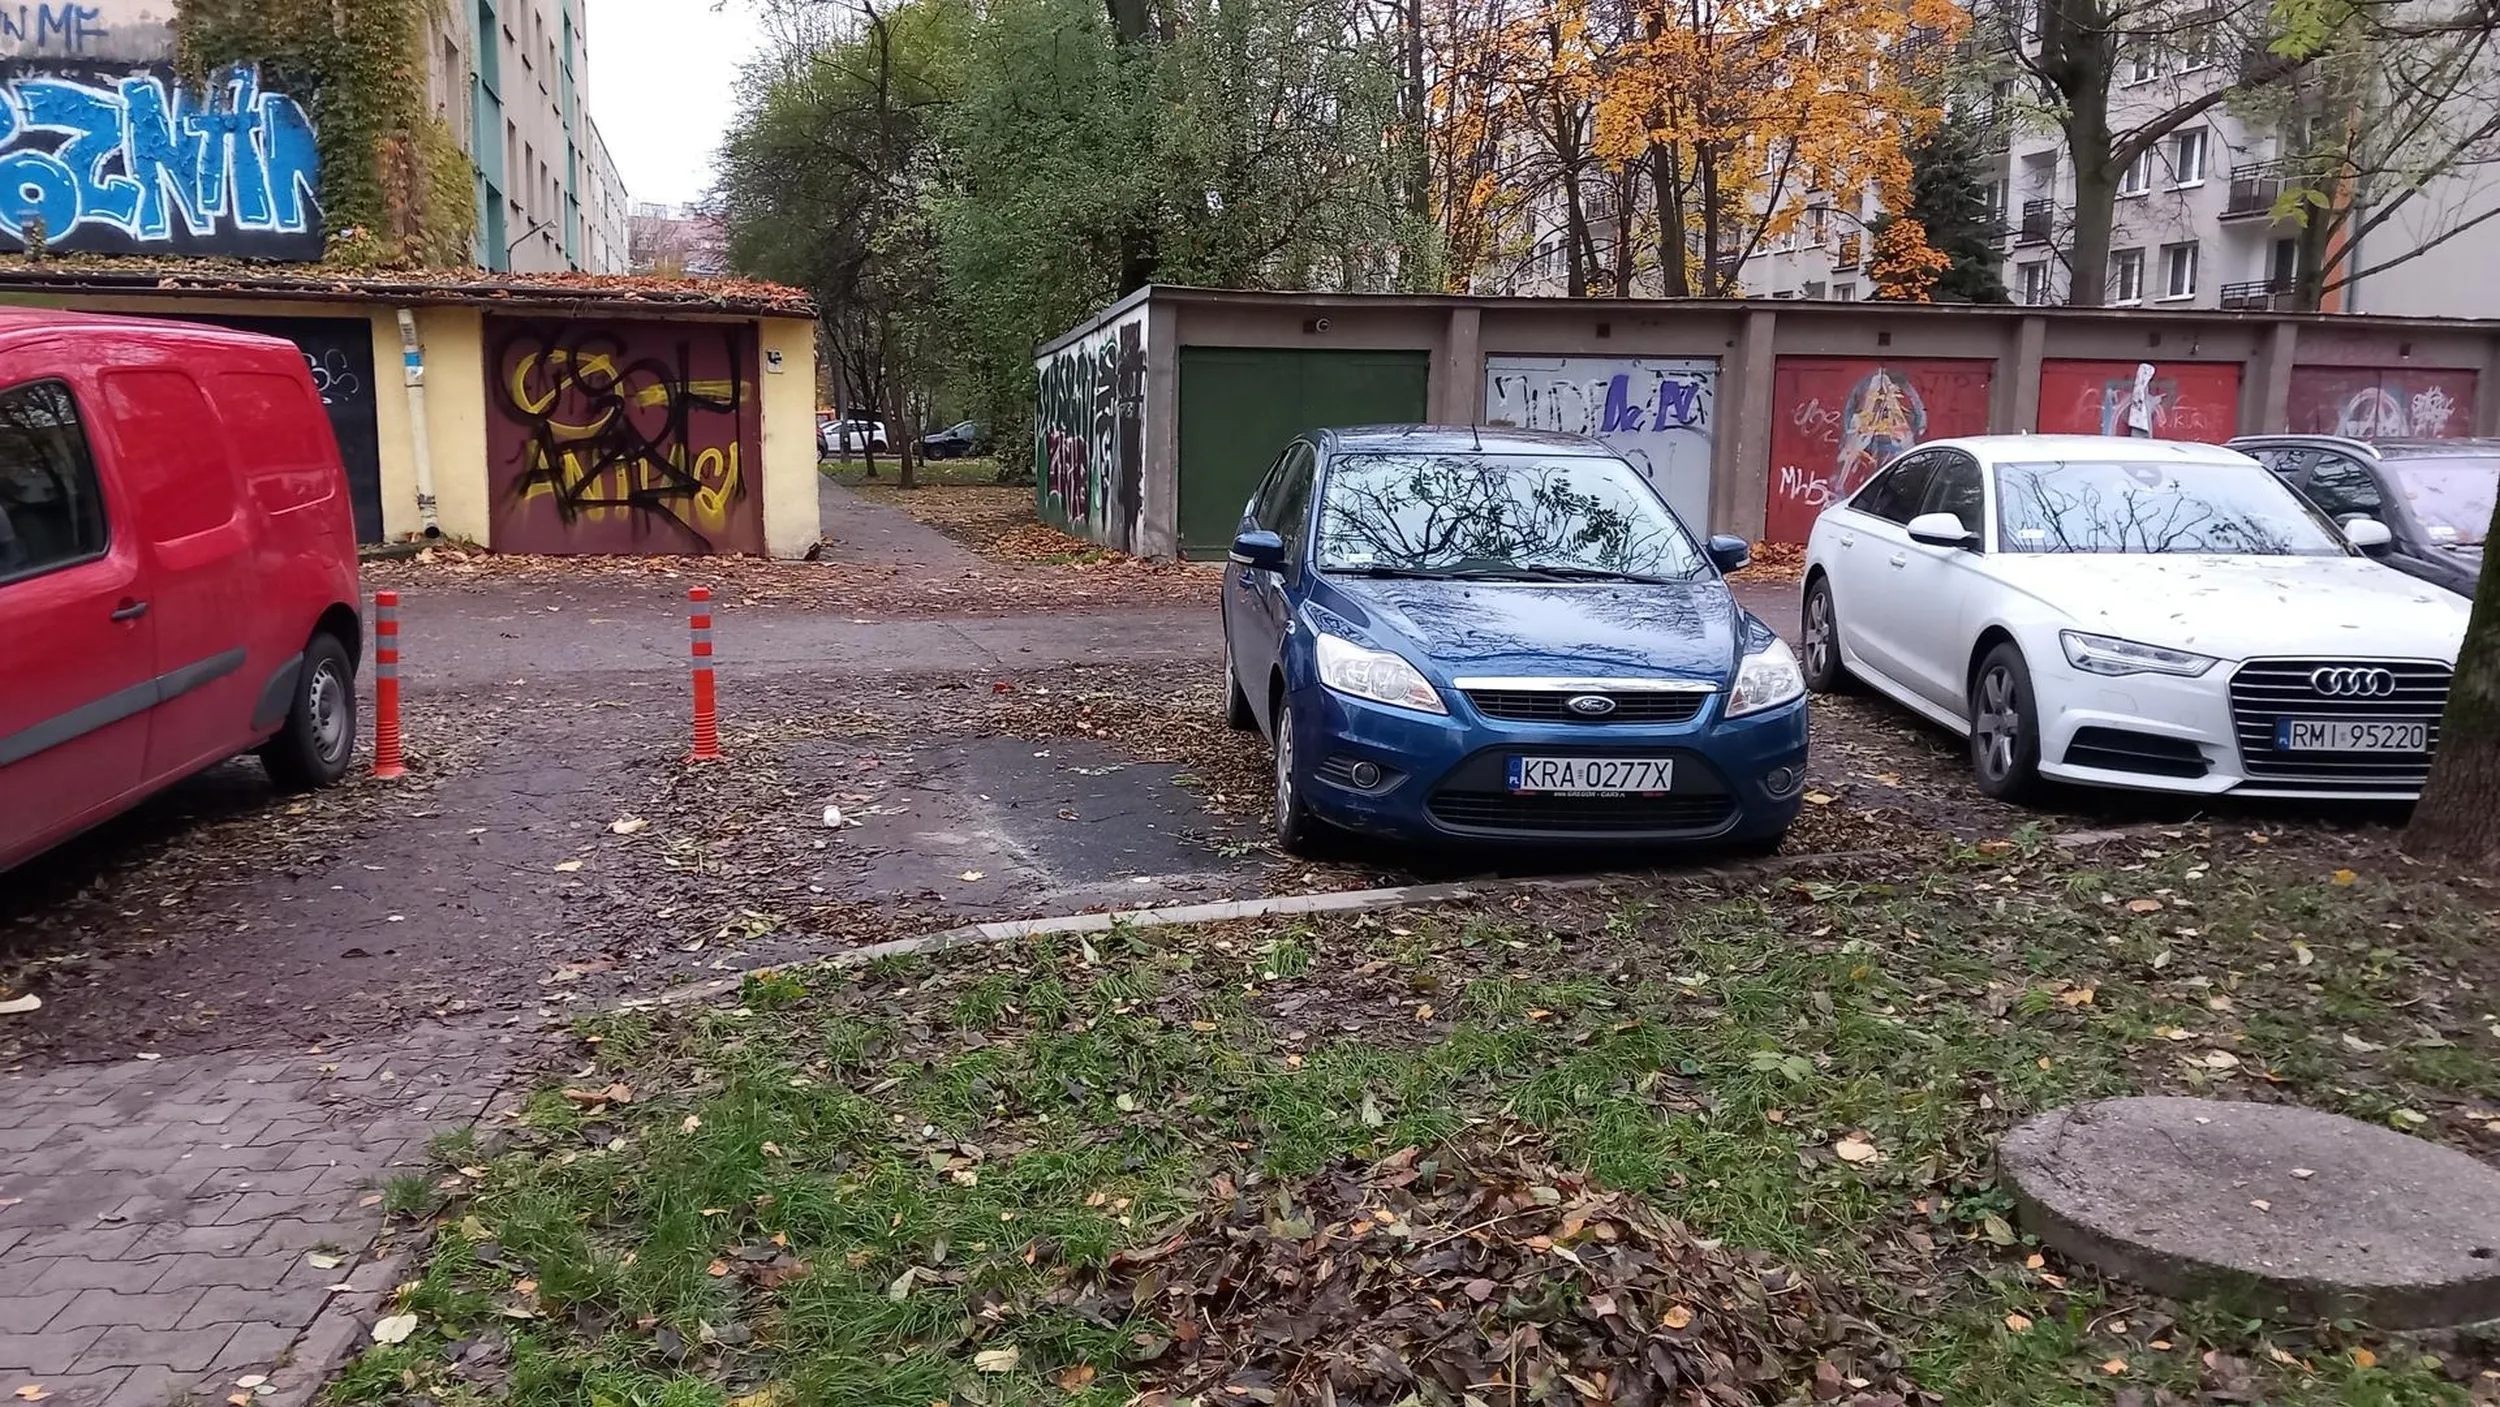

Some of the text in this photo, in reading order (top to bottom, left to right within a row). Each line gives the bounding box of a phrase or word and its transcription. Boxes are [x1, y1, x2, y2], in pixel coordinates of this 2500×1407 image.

[2292, 723, 2424, 749] RMI 95220
[1523, 761, 1669, 788] KRA 0277X
